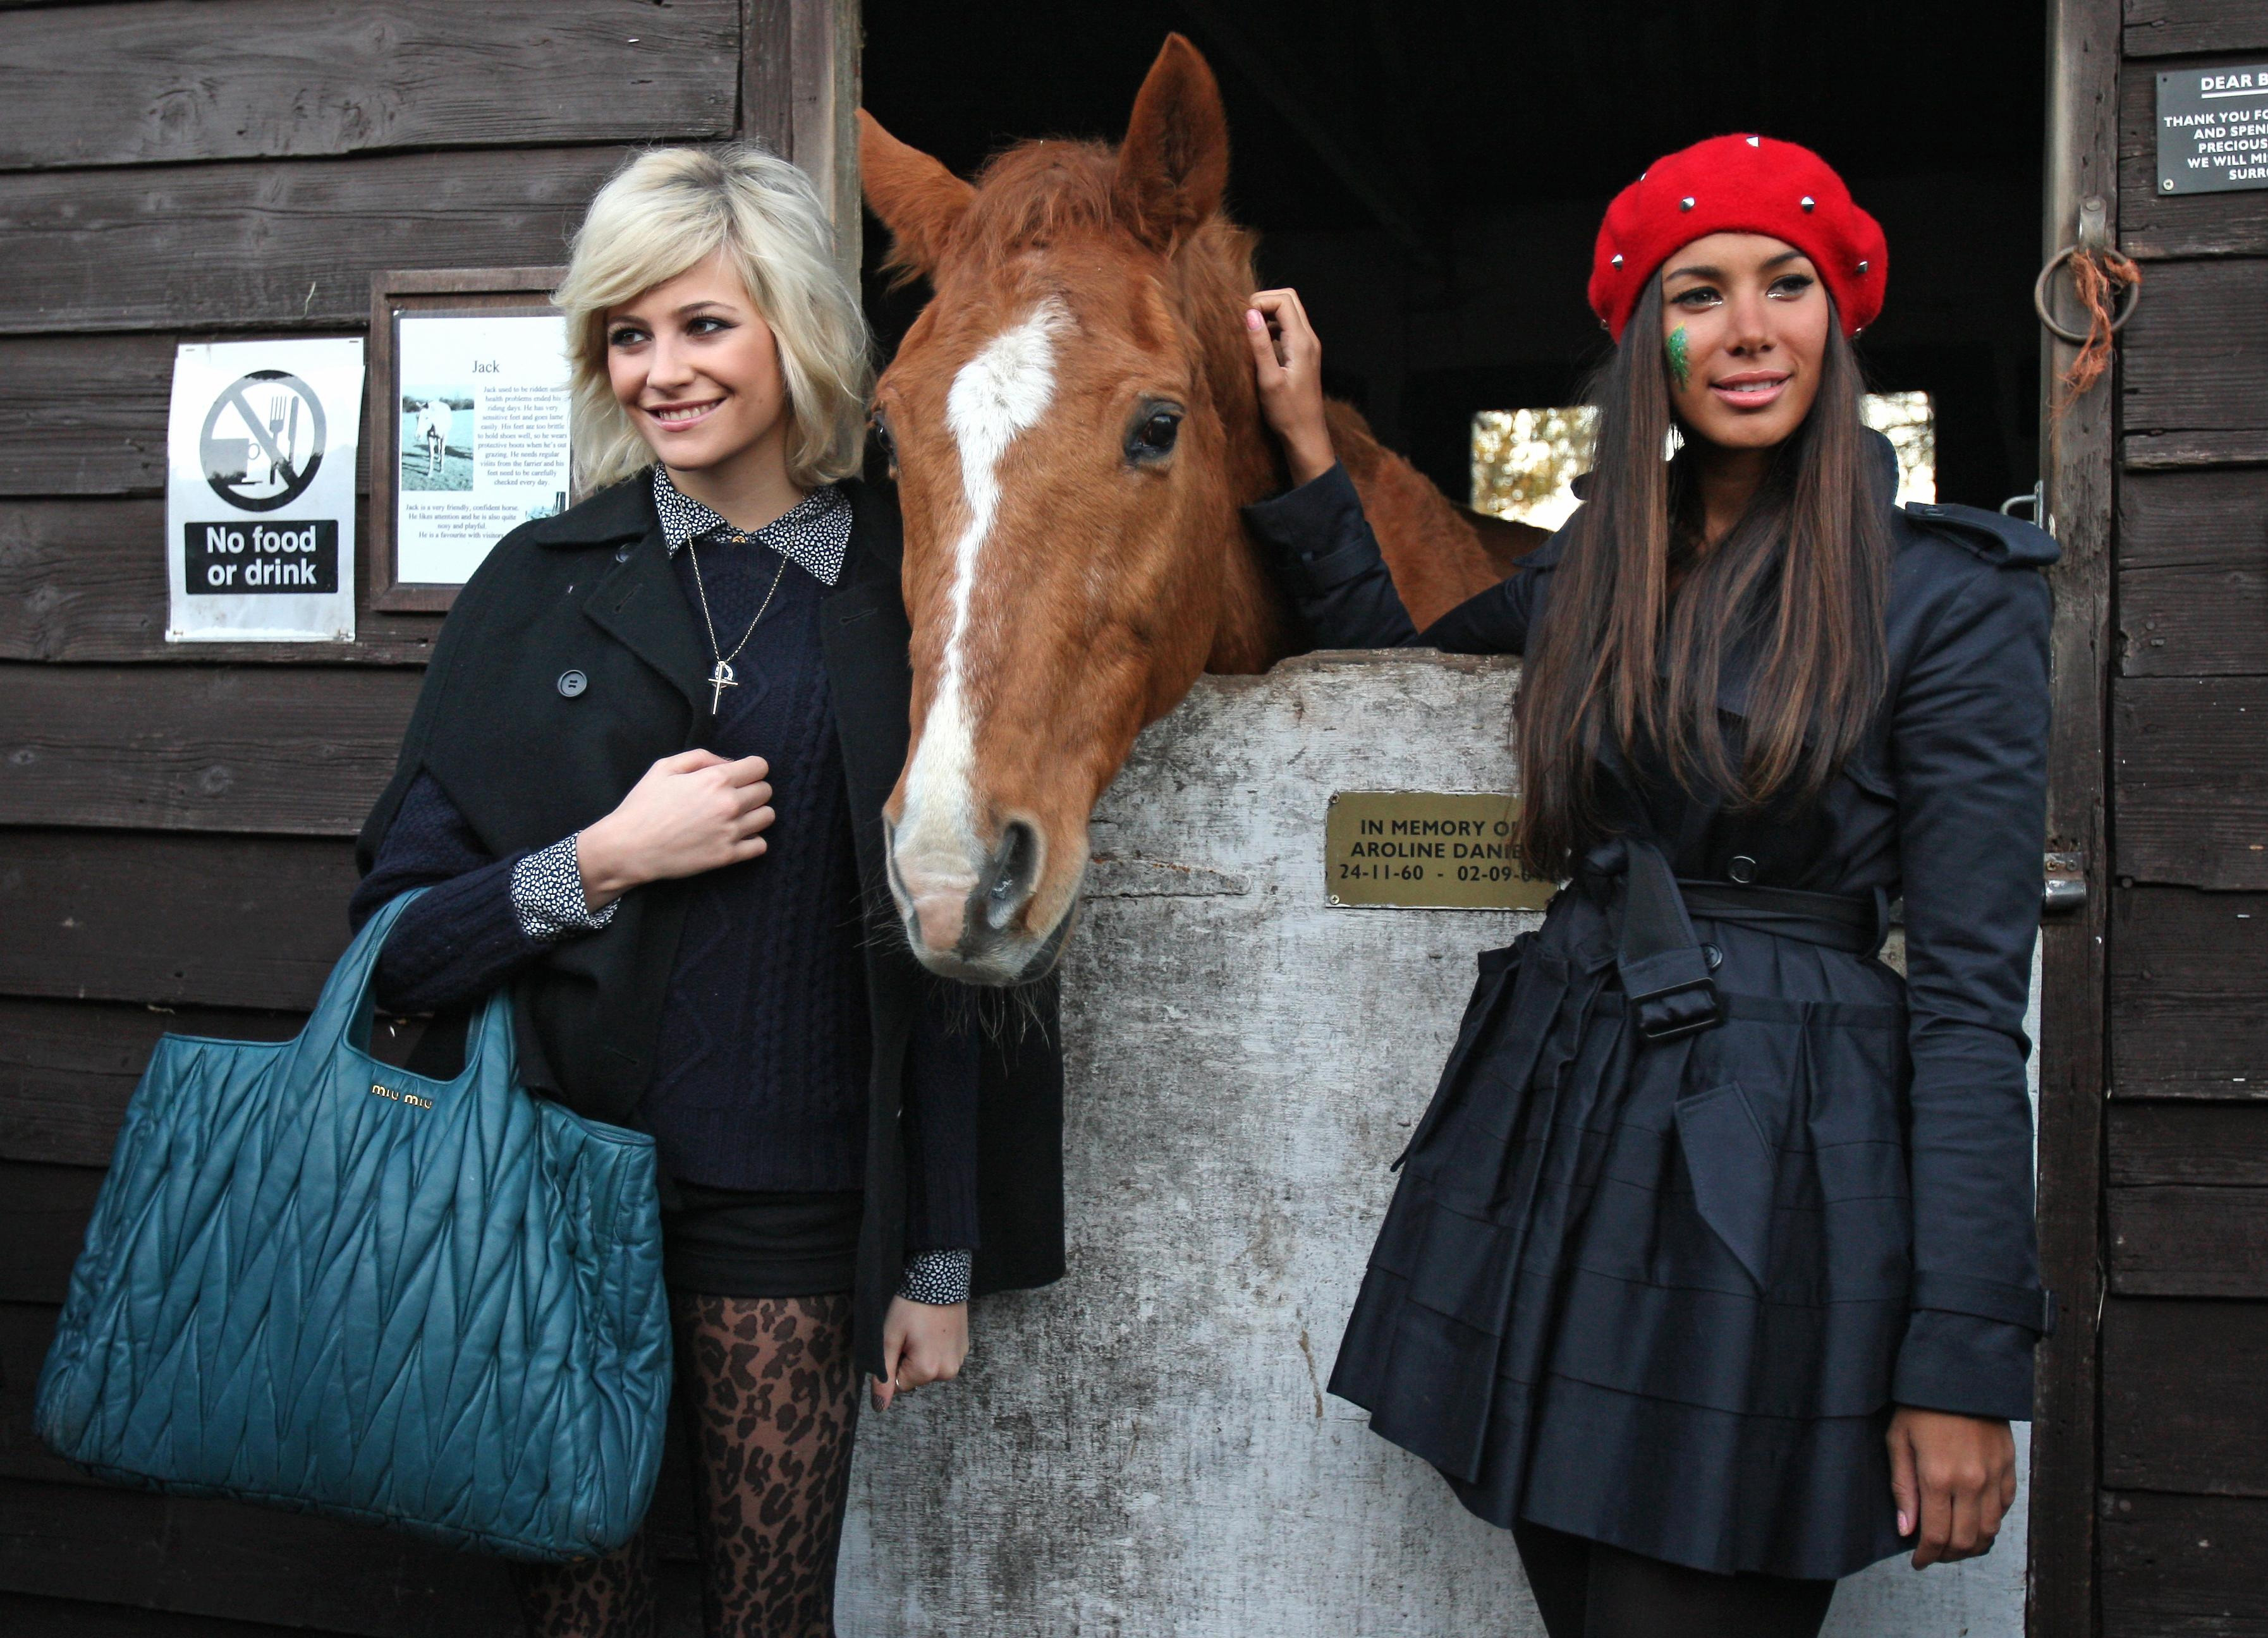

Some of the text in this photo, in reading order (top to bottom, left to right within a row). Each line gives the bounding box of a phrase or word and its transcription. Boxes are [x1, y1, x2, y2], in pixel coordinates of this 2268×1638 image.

[2201, 74, 2252, 91] DEAR
[2164, 113, 2215, 127] THANK
[2219, 110, 2250, 123] YOU
[2193, 124, 2268, 139] AND SPEN
[2198, 138, 2268, 154] PRECIOUS
[2187, 152, 2268, 168] WE WILL MI
[472, 360, 500, 373] Jack
[539, 451, 559, 459] regular
[207, 525, 316, 553] No food
[208, 559, 317, 586] or drink
[1361, 820, 1383, 835] IN
[1392, 820, 1485, 836] MEMORY
[1351, 842, 1445, 858] AROLINE
[1340, 864, 1424, 880] 24-11-60
